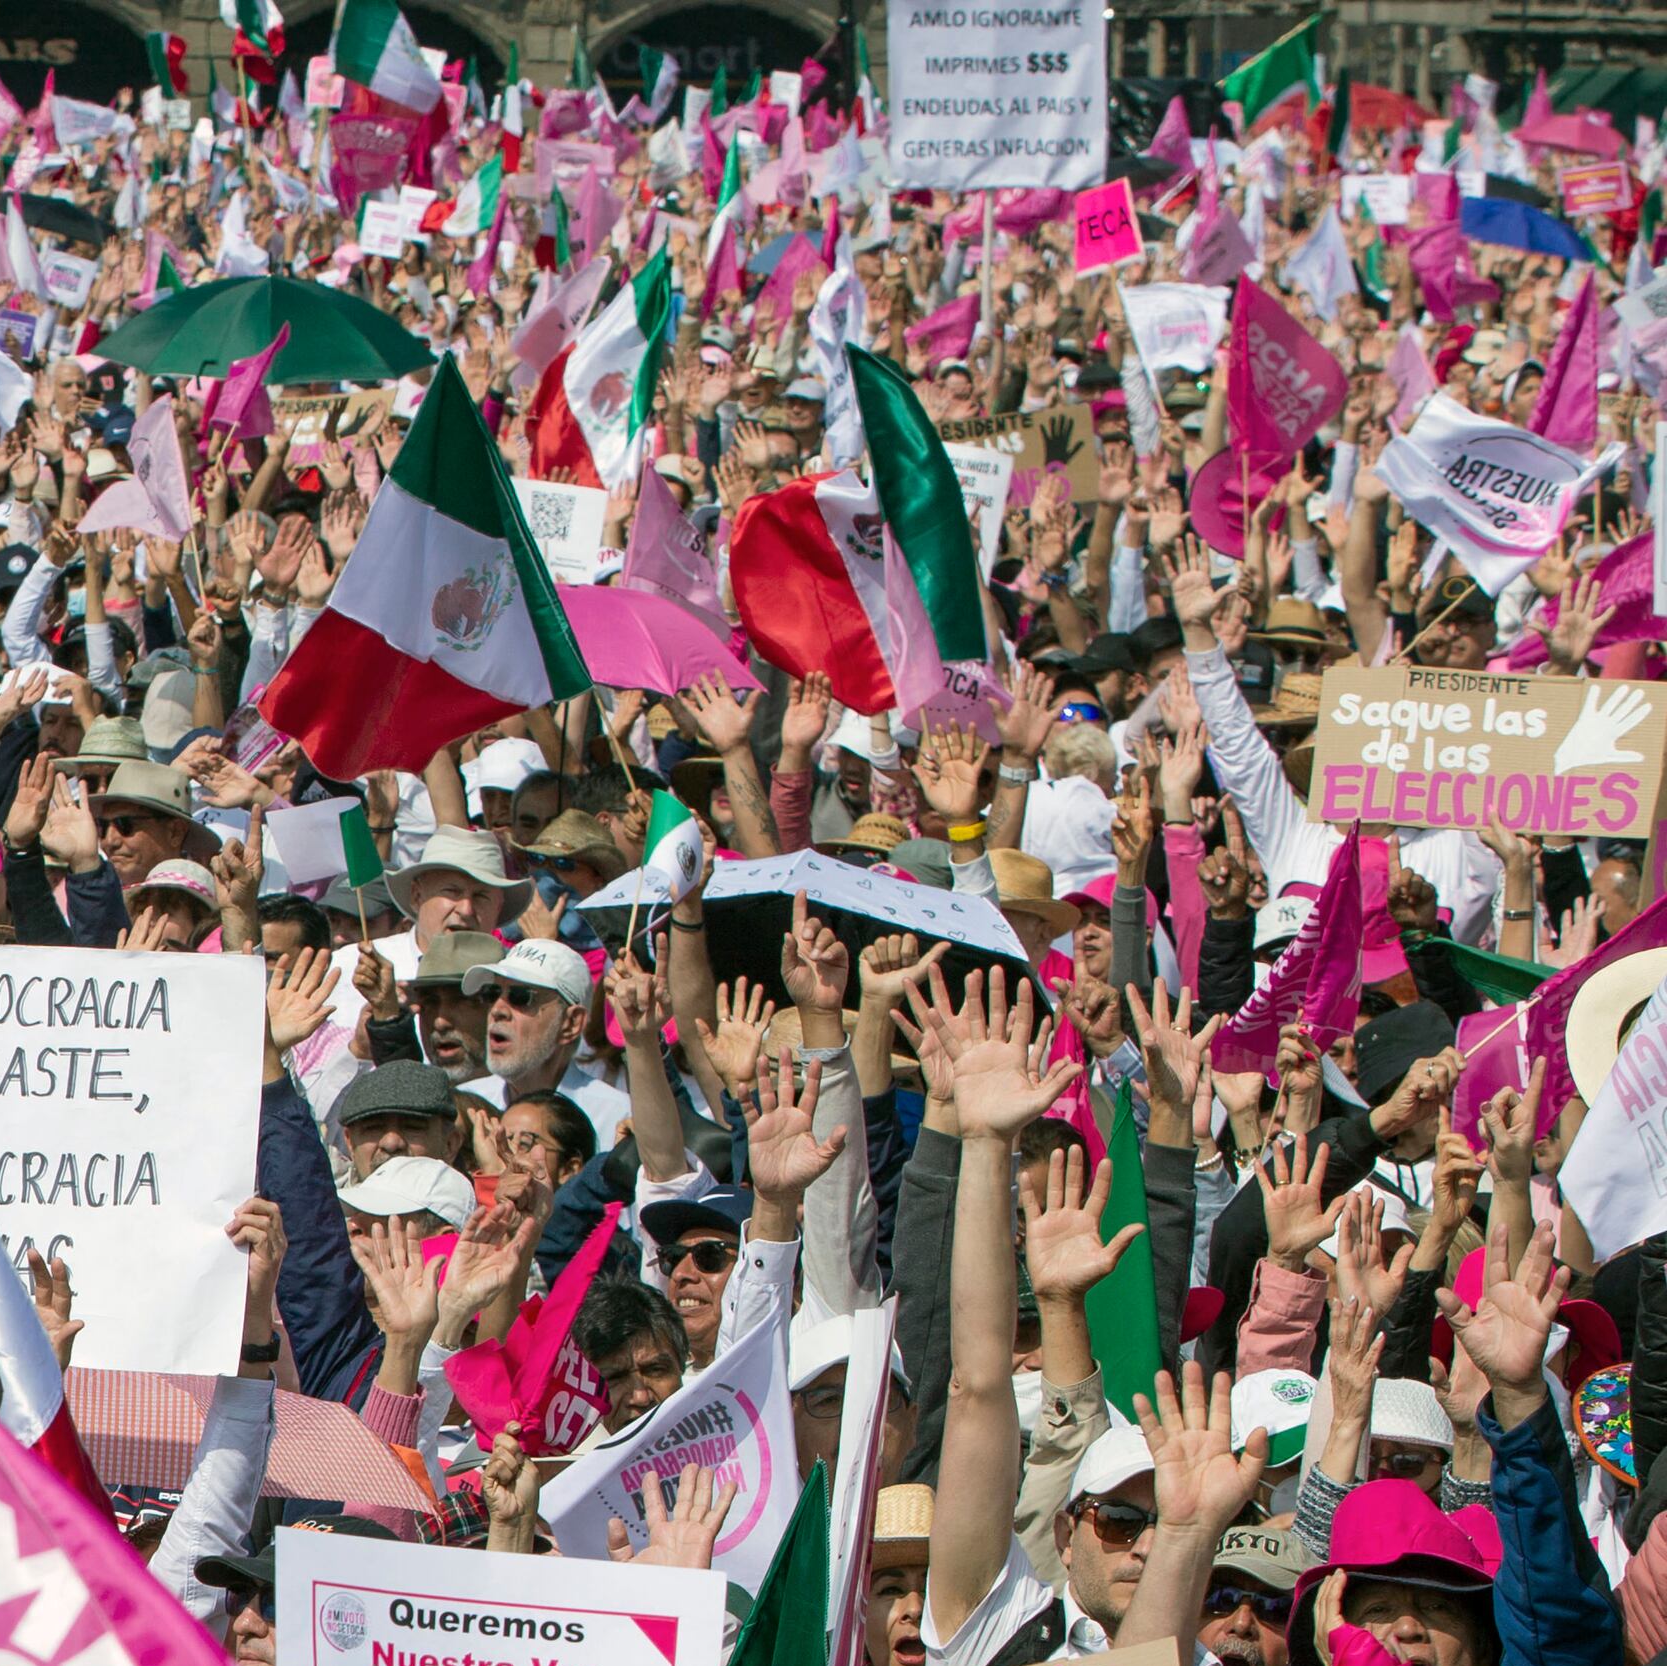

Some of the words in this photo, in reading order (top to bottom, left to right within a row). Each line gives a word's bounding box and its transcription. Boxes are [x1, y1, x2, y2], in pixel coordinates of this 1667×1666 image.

[910, 10, 964, 27] AMLO
[972, 9, 1082, 28] IGNORANTE
[925, 57, 1021, 74] IMPRIMES
[1027, 52, 1069, 74] $$$
[904, 98, 1003, 116] ENDEUDAS
[1011, 98, 1031, 115] AL
[1079, 97, 1091, 114] Y
[904, 140, 989, 158] GENERAS
[941, 414, 1034, 440] ESIDENTE
[1409, 671, 1532, 696] PRESIDENTE
[1483, 698, 1548, 739] las
[1361, 728, 1410, 773] de
[1423, 736, 1492, 775] las
[1320, 764, 1641, 833] ELECCIONES
[327, 1622, 365, 1636] NOSETOCA
[328, 1610, 365, 1625] #MIVOTO
[389, 1598, 586, 1643] Queremos
